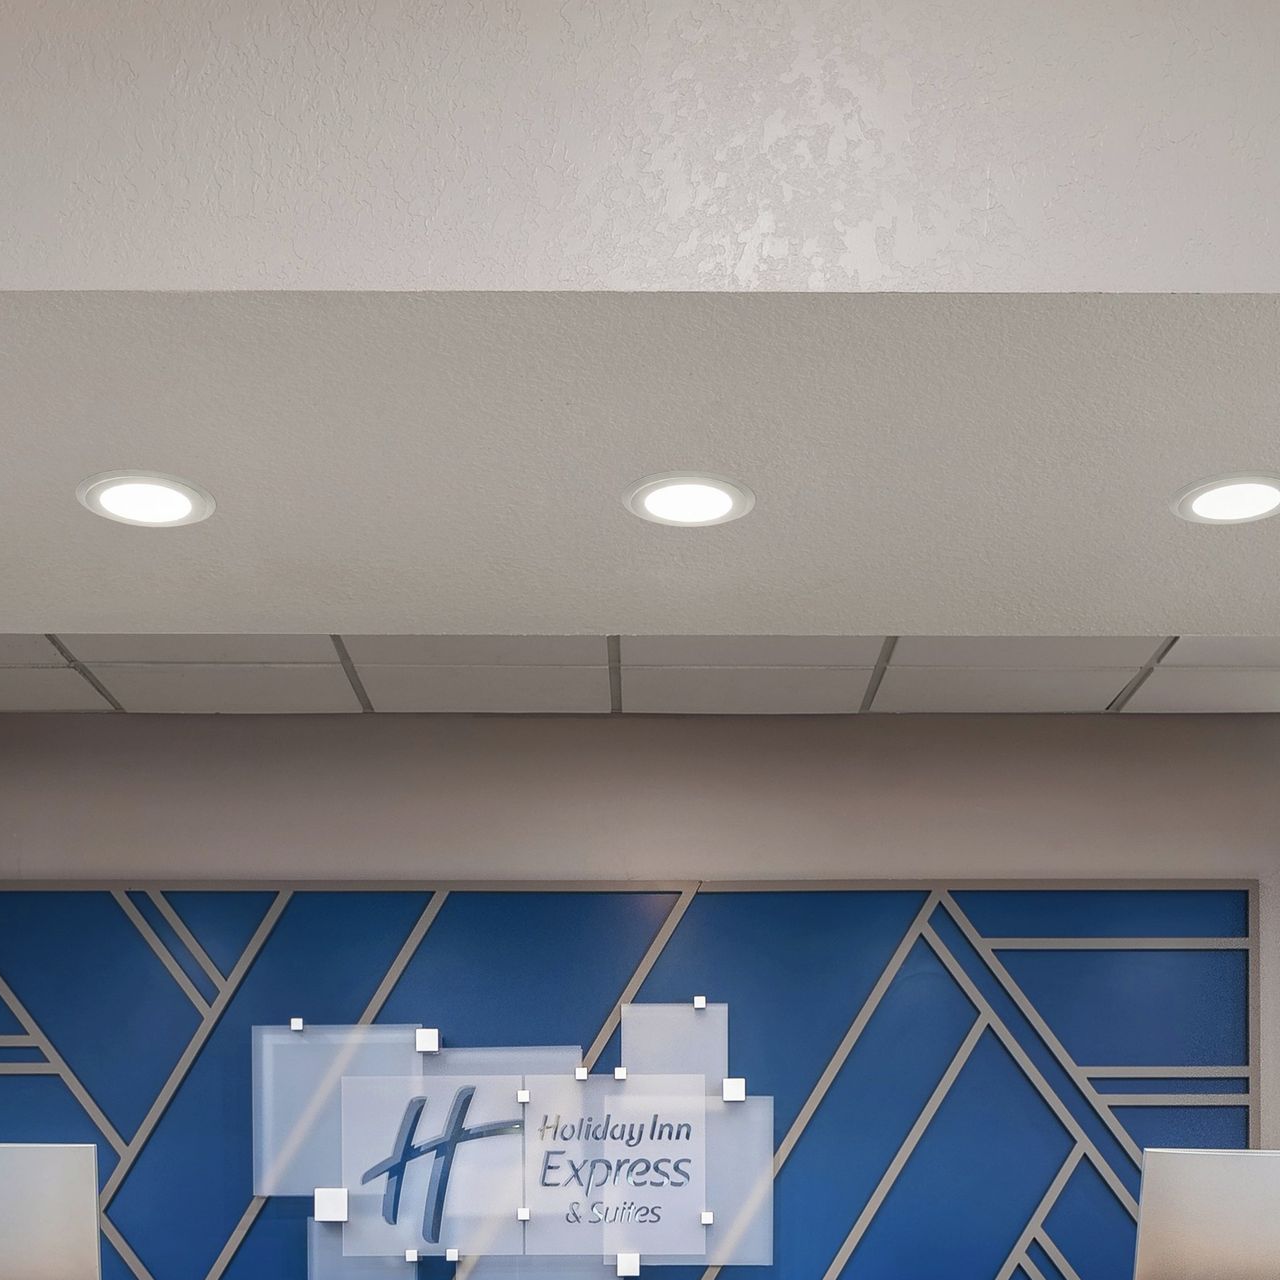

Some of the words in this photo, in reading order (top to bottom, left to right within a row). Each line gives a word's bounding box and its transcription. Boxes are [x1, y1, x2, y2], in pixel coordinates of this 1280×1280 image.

[538, 1114, 645, 1147] Holiday
[649, 1114, 692, 1141] Inn
[538, 1150, 692, 1197] Express
[565, 1202, 582, 1224] &
[587, 1201, 662, 1225] Suites
